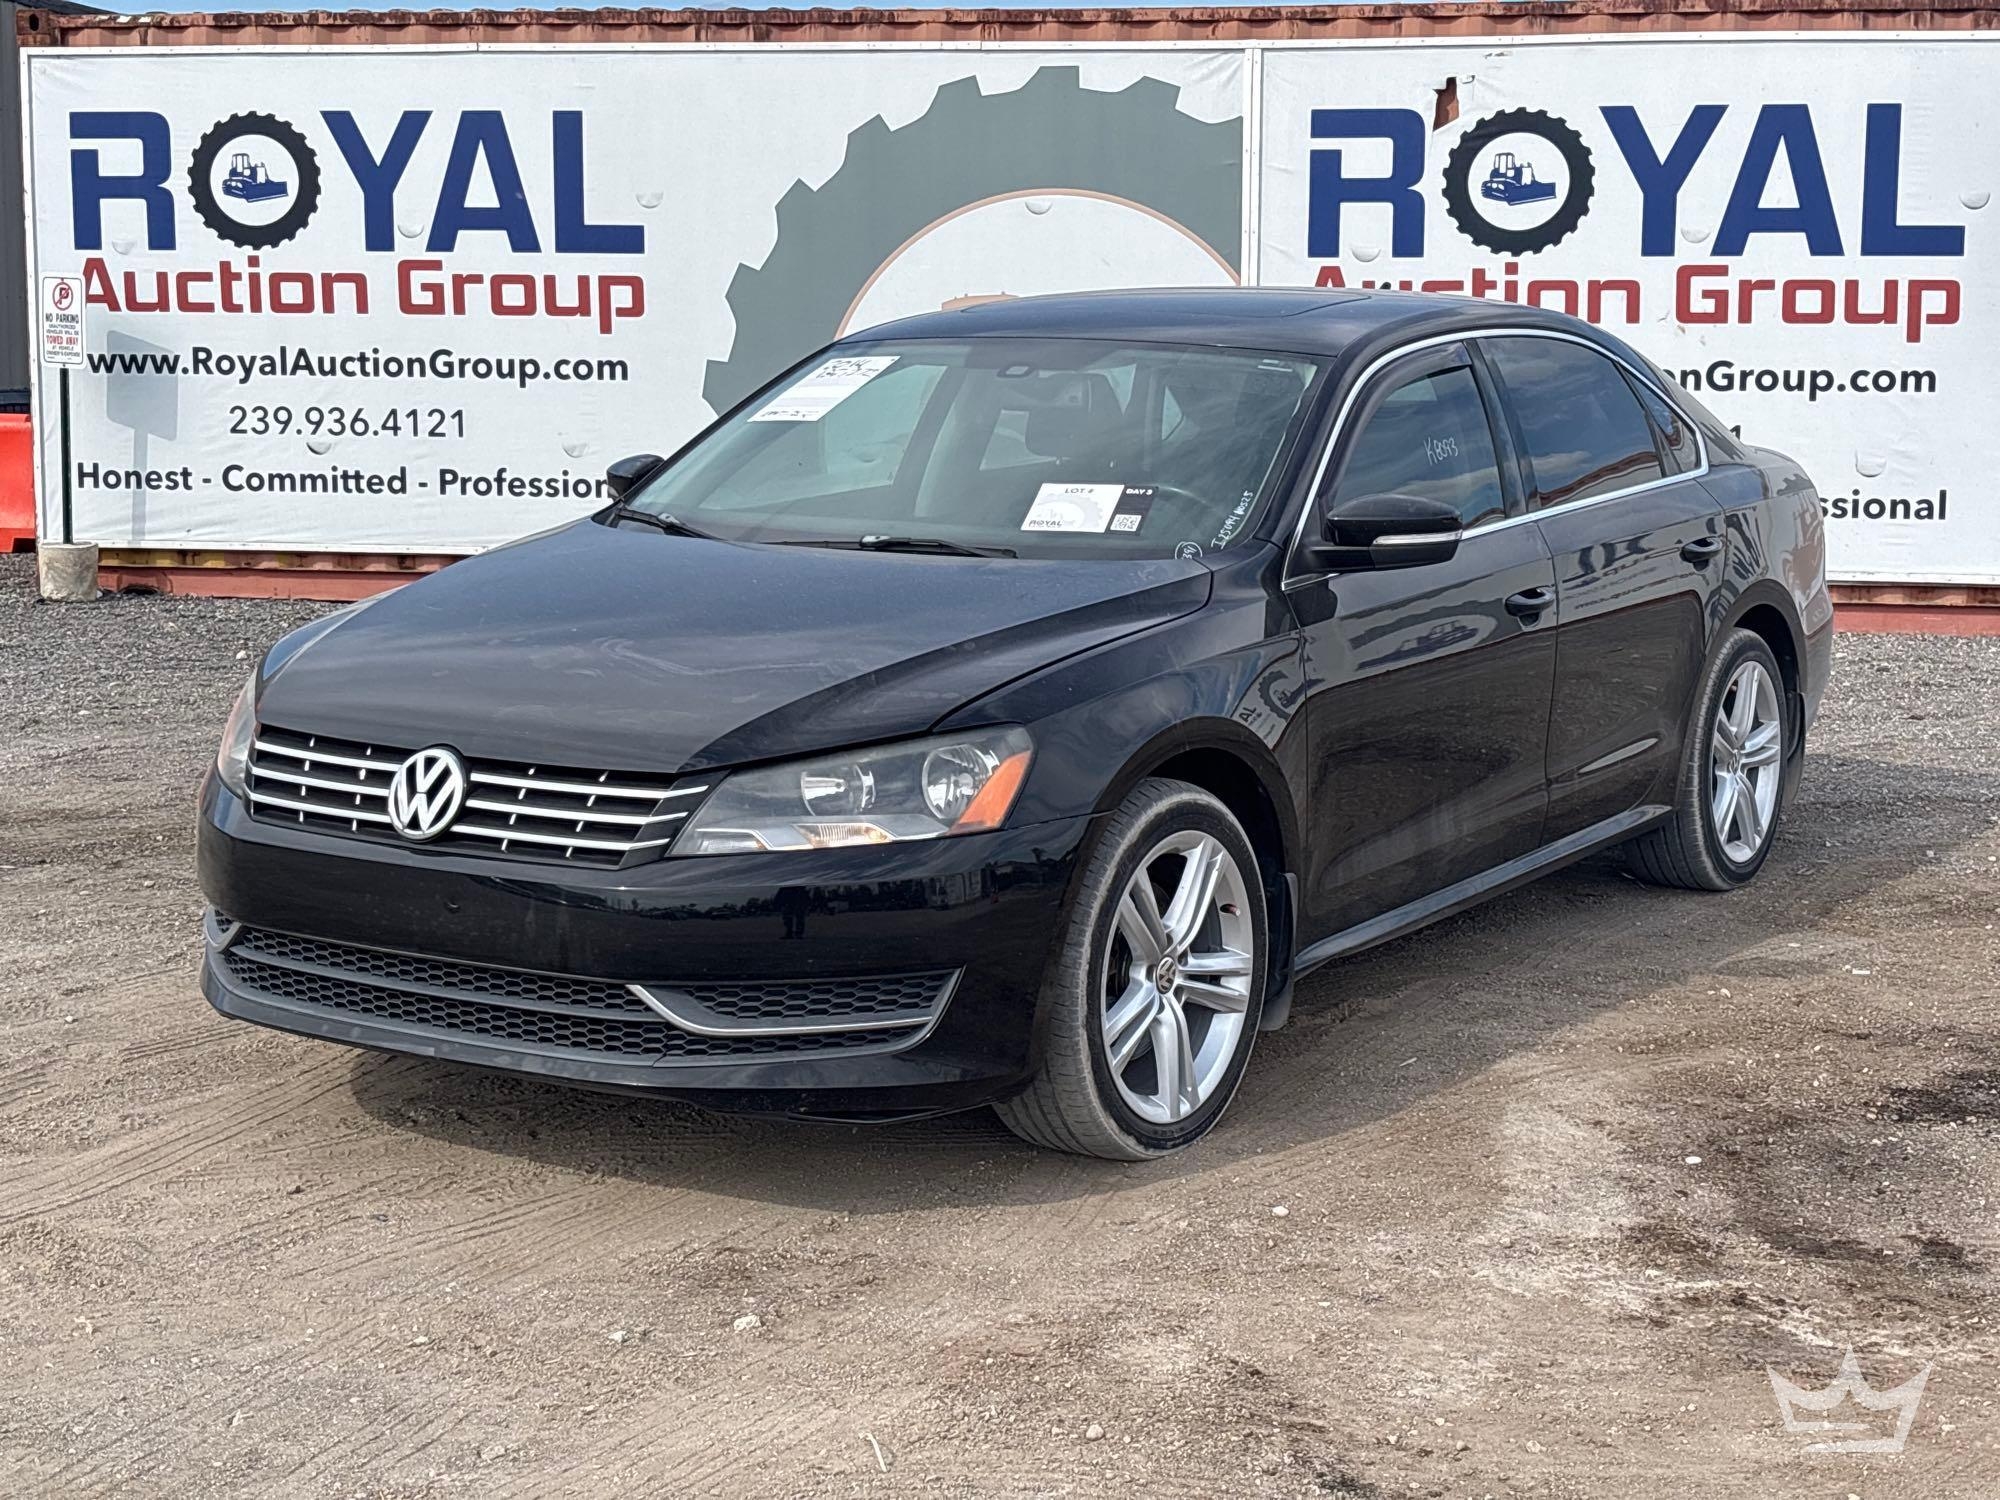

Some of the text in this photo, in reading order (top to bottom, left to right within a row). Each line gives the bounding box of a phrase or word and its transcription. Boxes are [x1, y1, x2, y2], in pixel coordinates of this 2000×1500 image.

[69, 111, 645, 254] ROYAL
[1308, 103, 1965, 257] ROYAL
[84, 255, 645, 335] Auction Group
[1675, 264, 1961, 343] Group
[45, 312, 79, 324] NO PARKING
[46, 335, 79, 346] TOWED AWAY
[88, 346, 629, 389] www.RoyalAuctionGroup.com
[229, 405, 464, 438] 239.936.4121
[77, 462, 192, 492] Honest
[222, 465, 407, 495] Committed
[1126, 488, 1145, 496] DAY
[388, 748, 464, 840] VW
